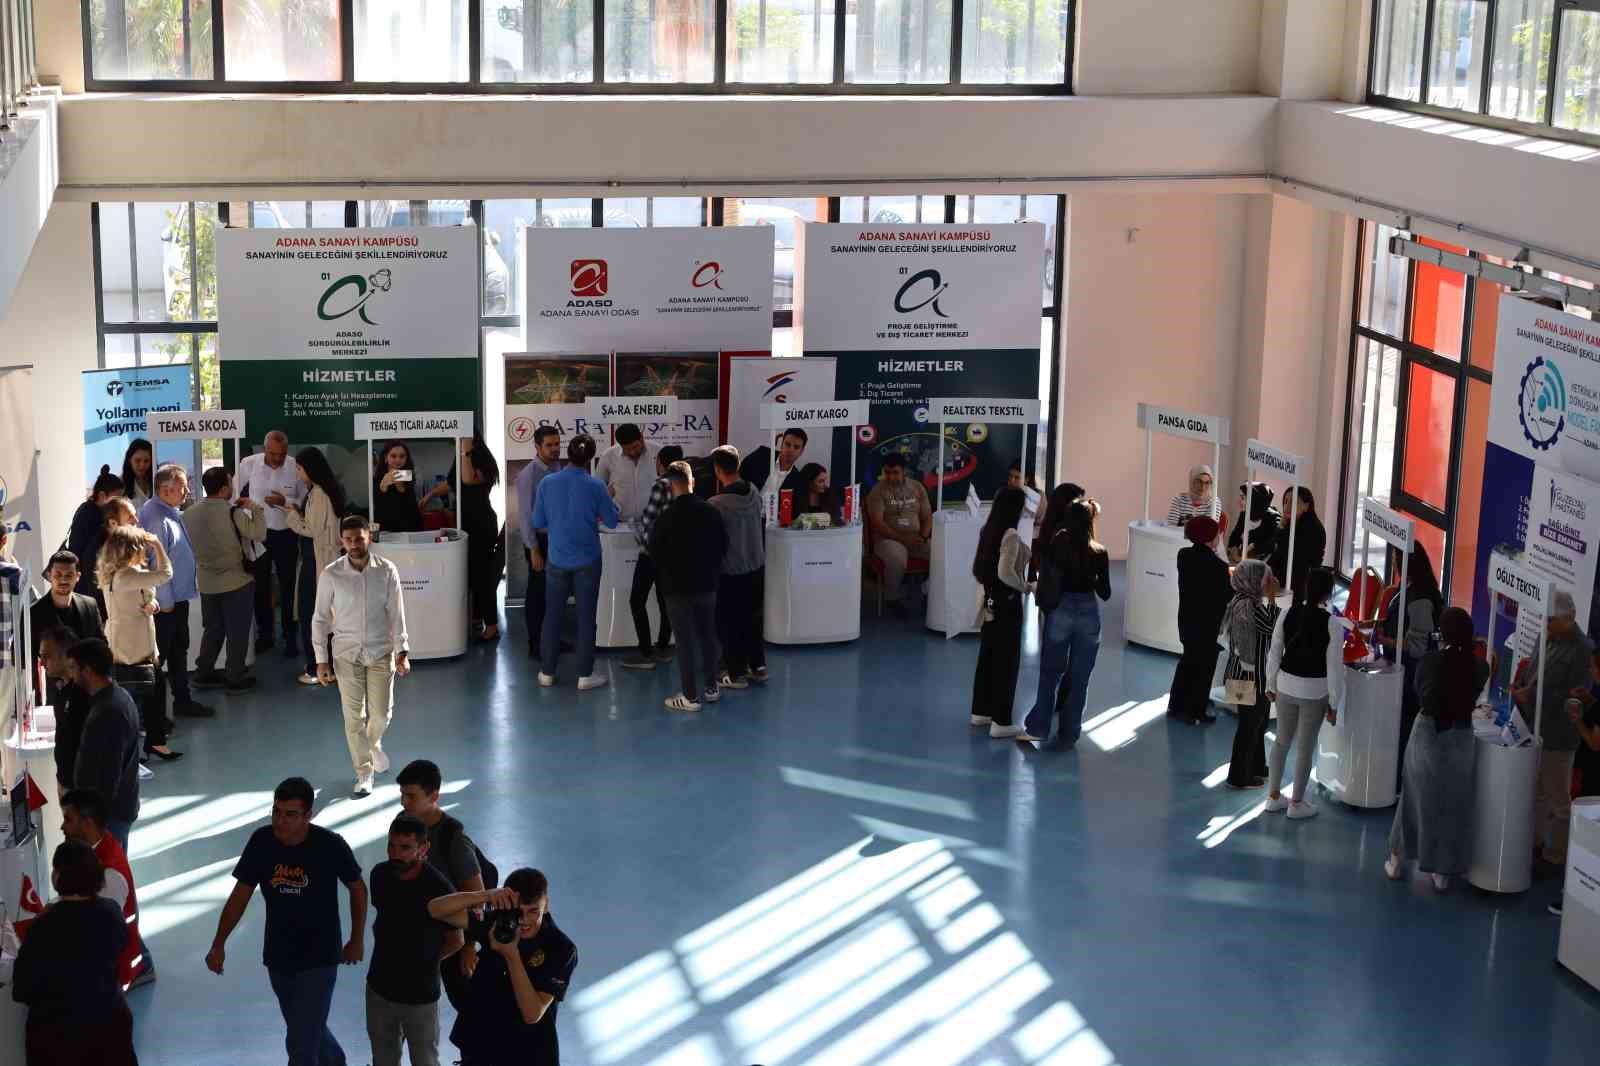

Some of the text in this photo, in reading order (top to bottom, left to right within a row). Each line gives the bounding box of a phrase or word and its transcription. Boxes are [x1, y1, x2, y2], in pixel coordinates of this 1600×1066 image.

[275, 235, 419, 247] ADANA SANAYİ KAMPÜSÜ
[859, 229, 991, 241] ADANA SANAYİ KAMPÜSÜ
[246, 248, 448, 260] SANAYİNİN GELECEĞİNİ ŞEKİLLENDİRİYORUZ
[831, 242, 1017, 254] SANAYİNİN GELECEĞİNİ ŞEKİLLENDİRİYORUZ
[321, 272, 331, 281] 01
[898, 266, 908, 275] 01
[566, 299, 613, 308] ADASO
[539, 308, 640, 318] ADANA SANAYİ ODASI
[1535, 318, 1558, 334] ADANA
[1559, 325, 1585, 342] SANAYİ
[877, 358, 964, 373] HİZMETLER
[302, 367, 397, 382] HİZMETLER
[126, 378, 170, 387] TEMSA
[96, 406, 148, 420] Yolların
[601, 400, 667, 418] ŞA-RA ENERJİ
[785, 407, 849, 421] SÜRAT KARGO
[943, 404, 1025, 417] REALTEKS TEKSTİL
[158, 419, 238, 433] TEMSA SKODA
[370, 417, 459, 434] TEKBAŞ TİCARİ ARAÇLAR
[1158, 413, 1209, 434] PANSA GIDA
[1496, 567, 1515, 588] OĞUZ
[1516, 576, 1541, 602] TEKSTİL
